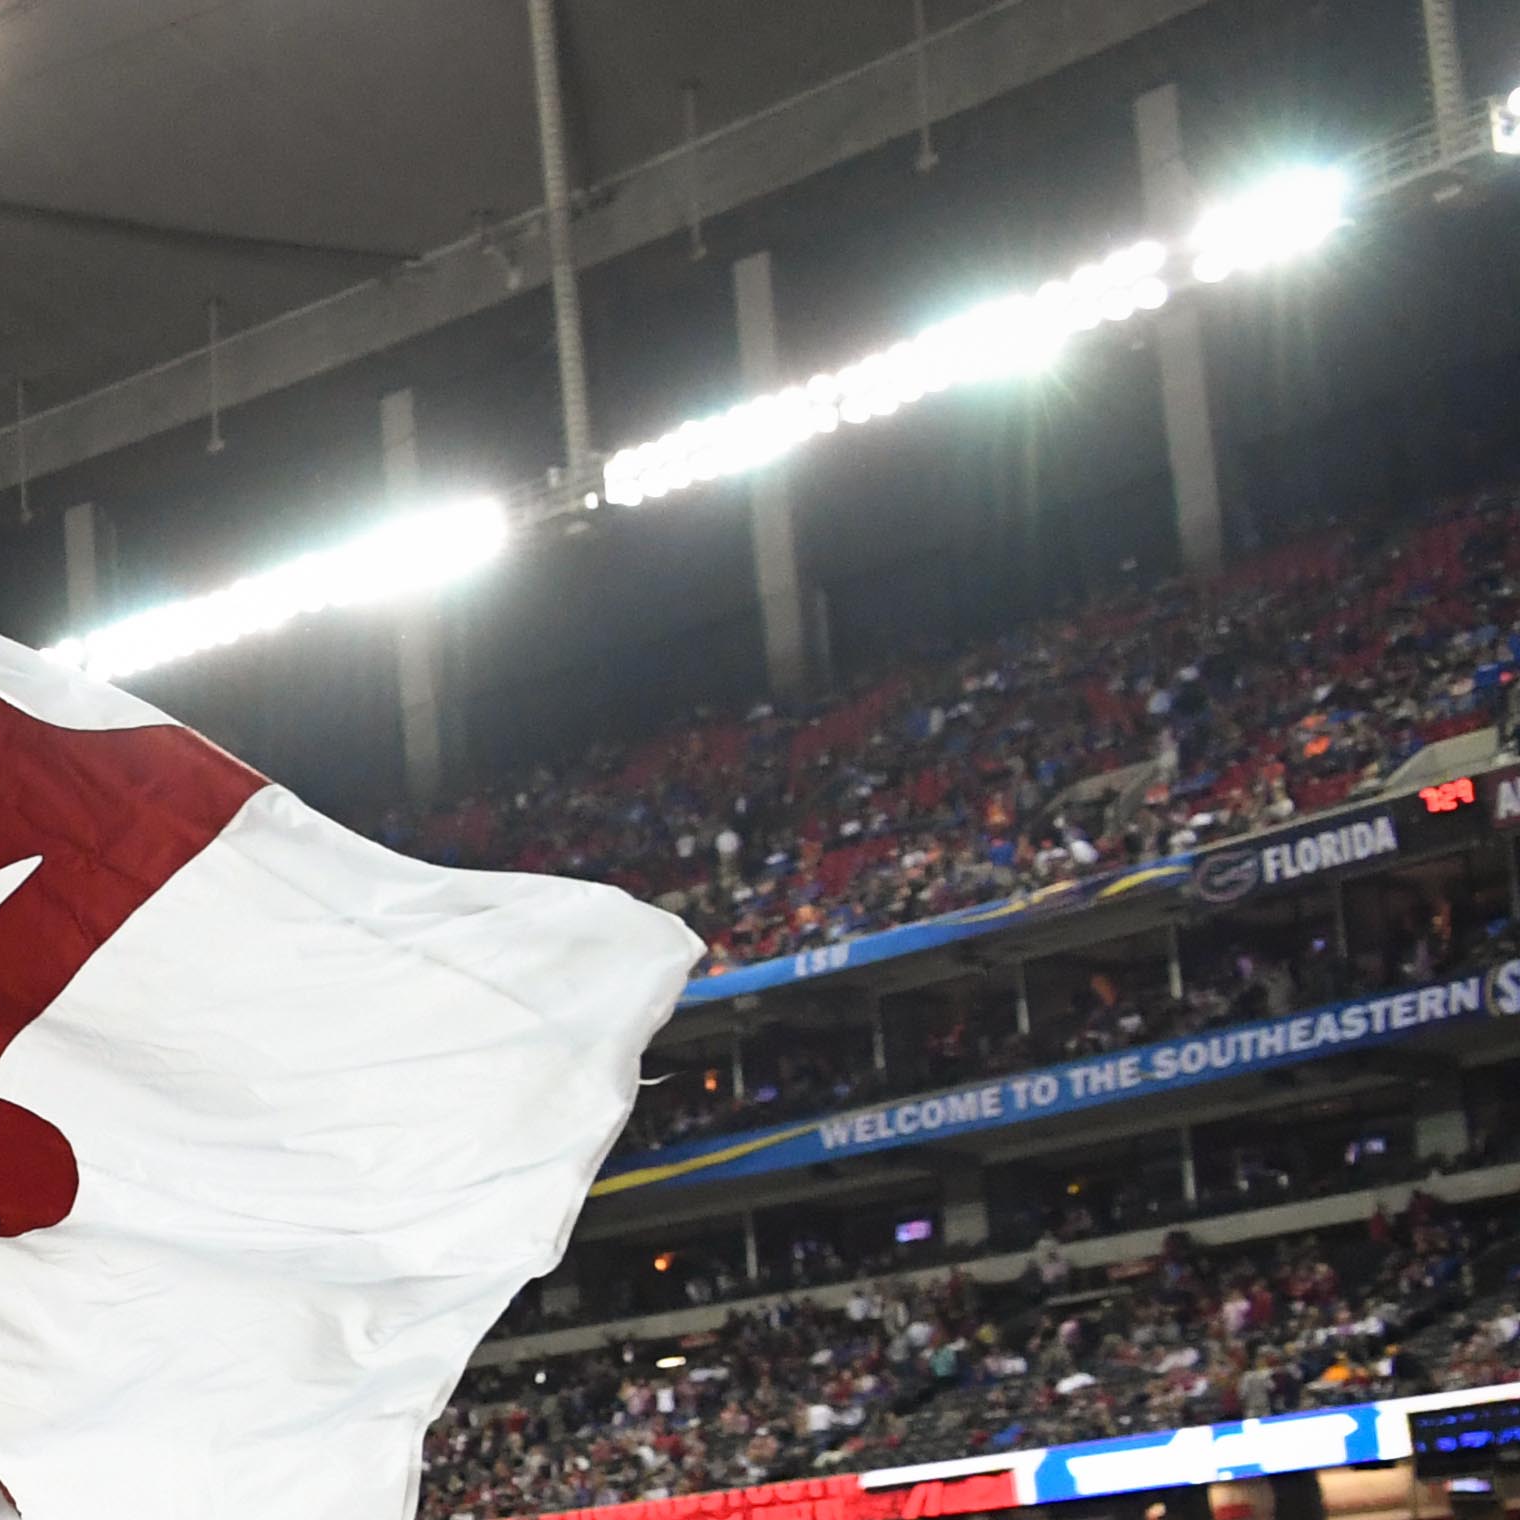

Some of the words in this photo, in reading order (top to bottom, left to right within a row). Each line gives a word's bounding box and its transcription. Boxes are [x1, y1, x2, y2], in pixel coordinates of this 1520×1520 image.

[1262, 816, 1398, 883] FLORIDA
[795, 941, 850, 978] LSU
[818, 1084, 1003, 1151] WELCOME
[1011, 1075, 1058, 1114] TO
[1069, 1056, 1142, 1099] THE
[1151, 976, 1480, 1083] SOUTHEASTERN
